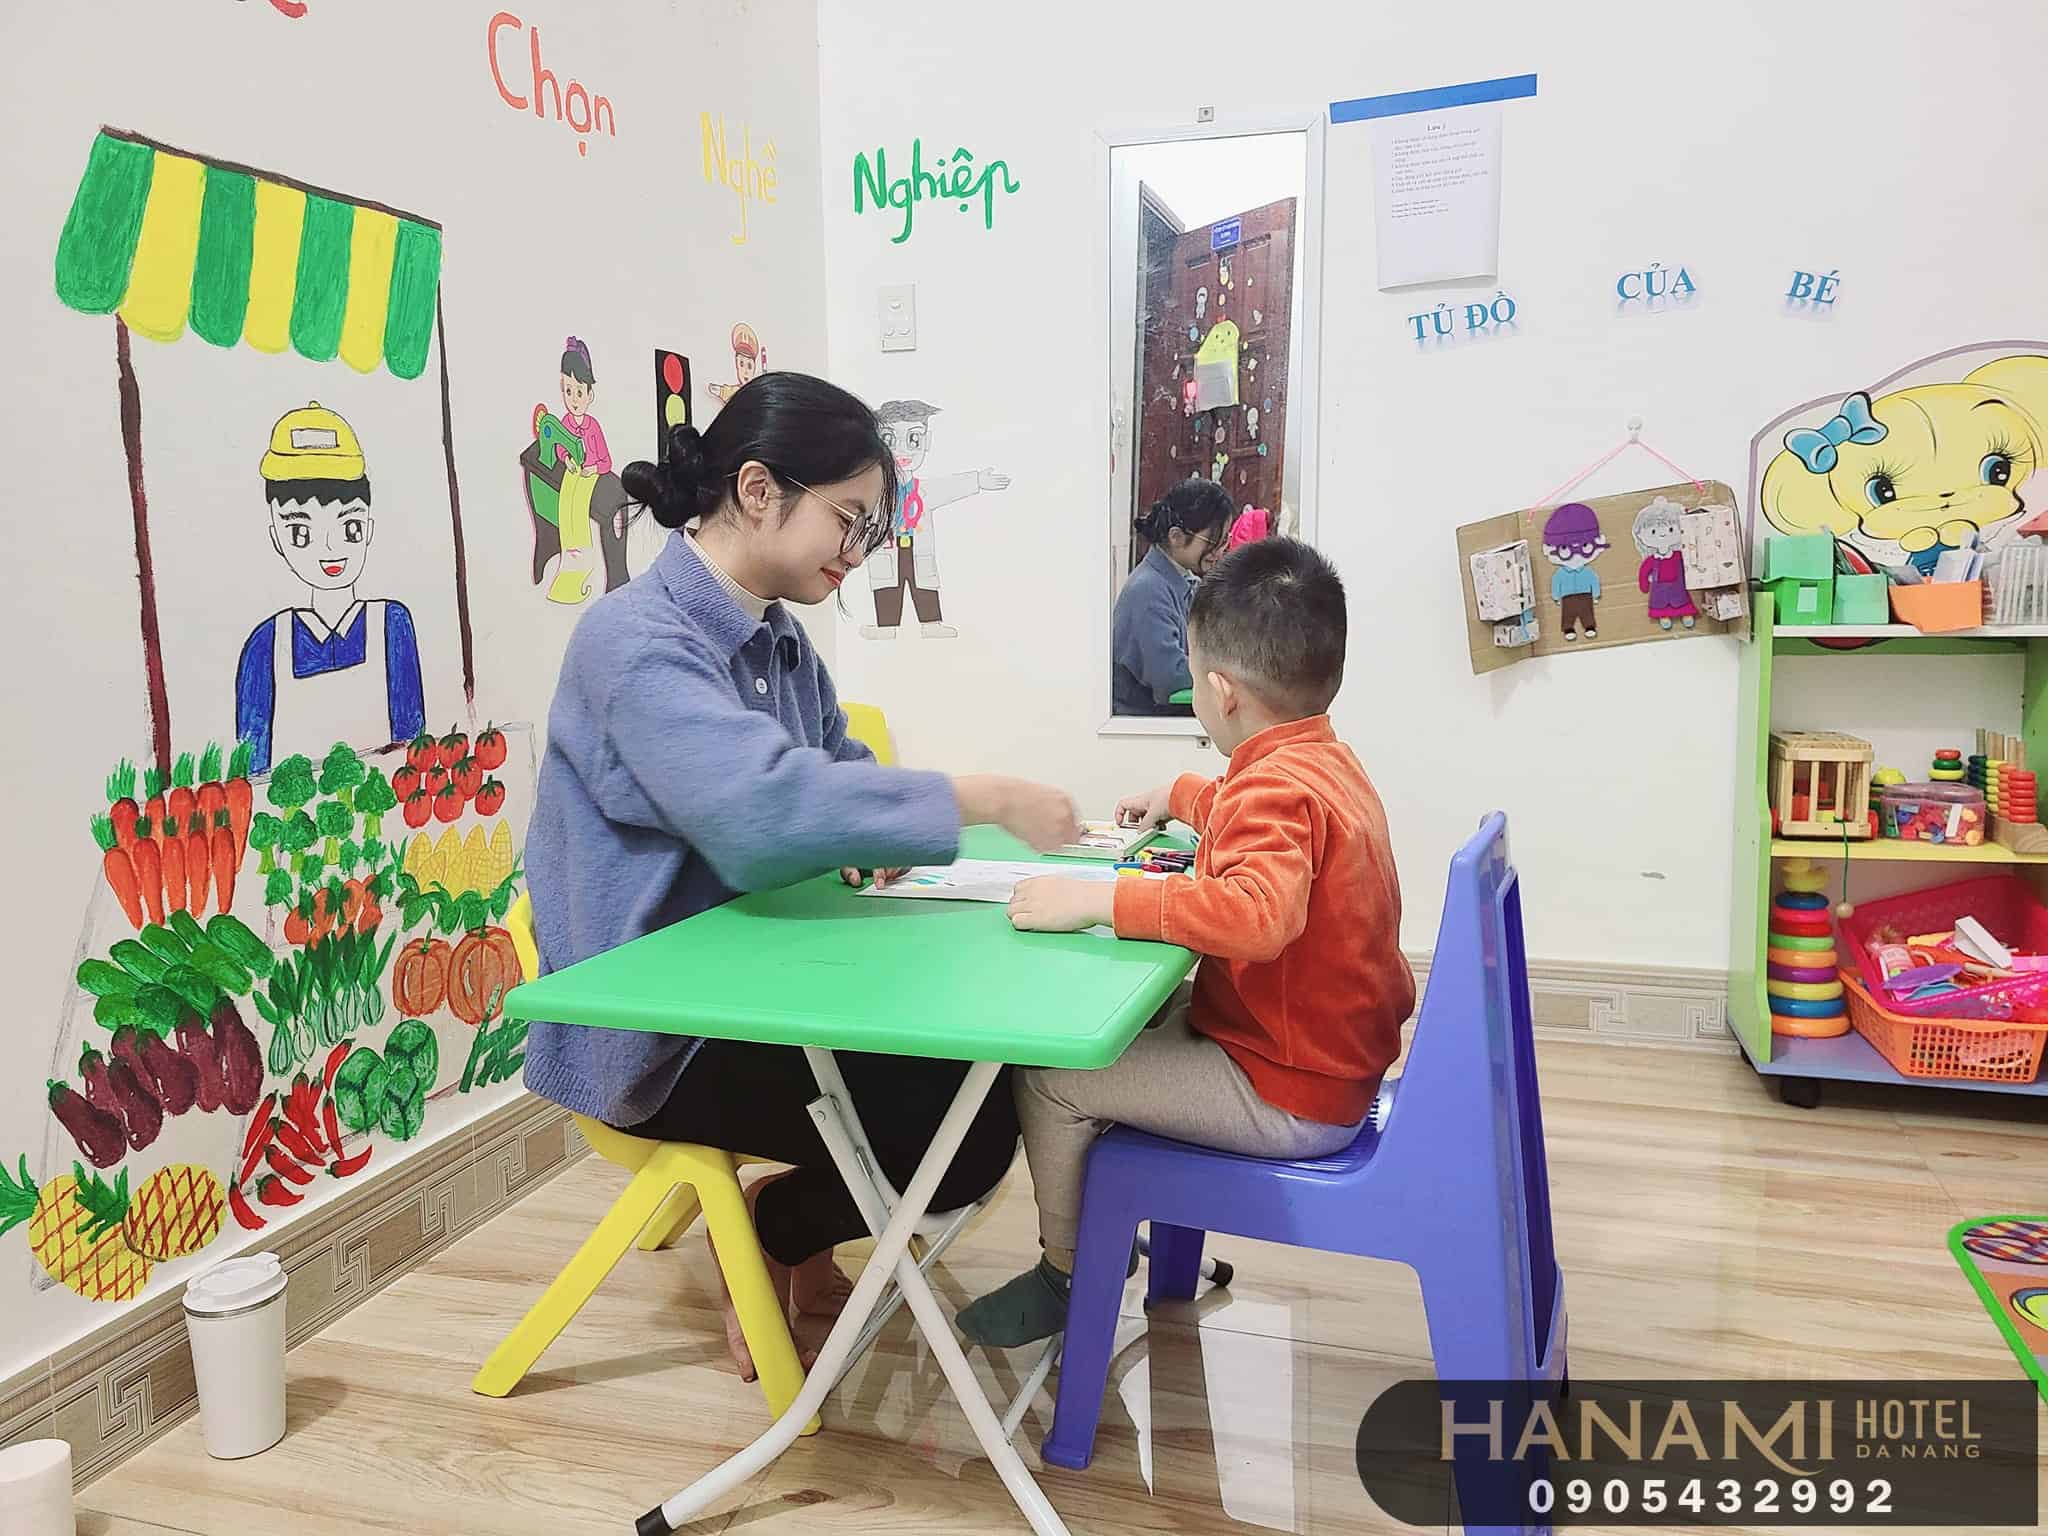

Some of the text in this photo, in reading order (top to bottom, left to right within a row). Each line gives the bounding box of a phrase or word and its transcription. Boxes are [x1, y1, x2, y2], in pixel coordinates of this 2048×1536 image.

[487, 11, 616, 156] Chọn
[853, 138, 1021, 244] Nghiệp
[1408, 262, 1841, 340] TỦ ĐỒ CỦA BÉ
